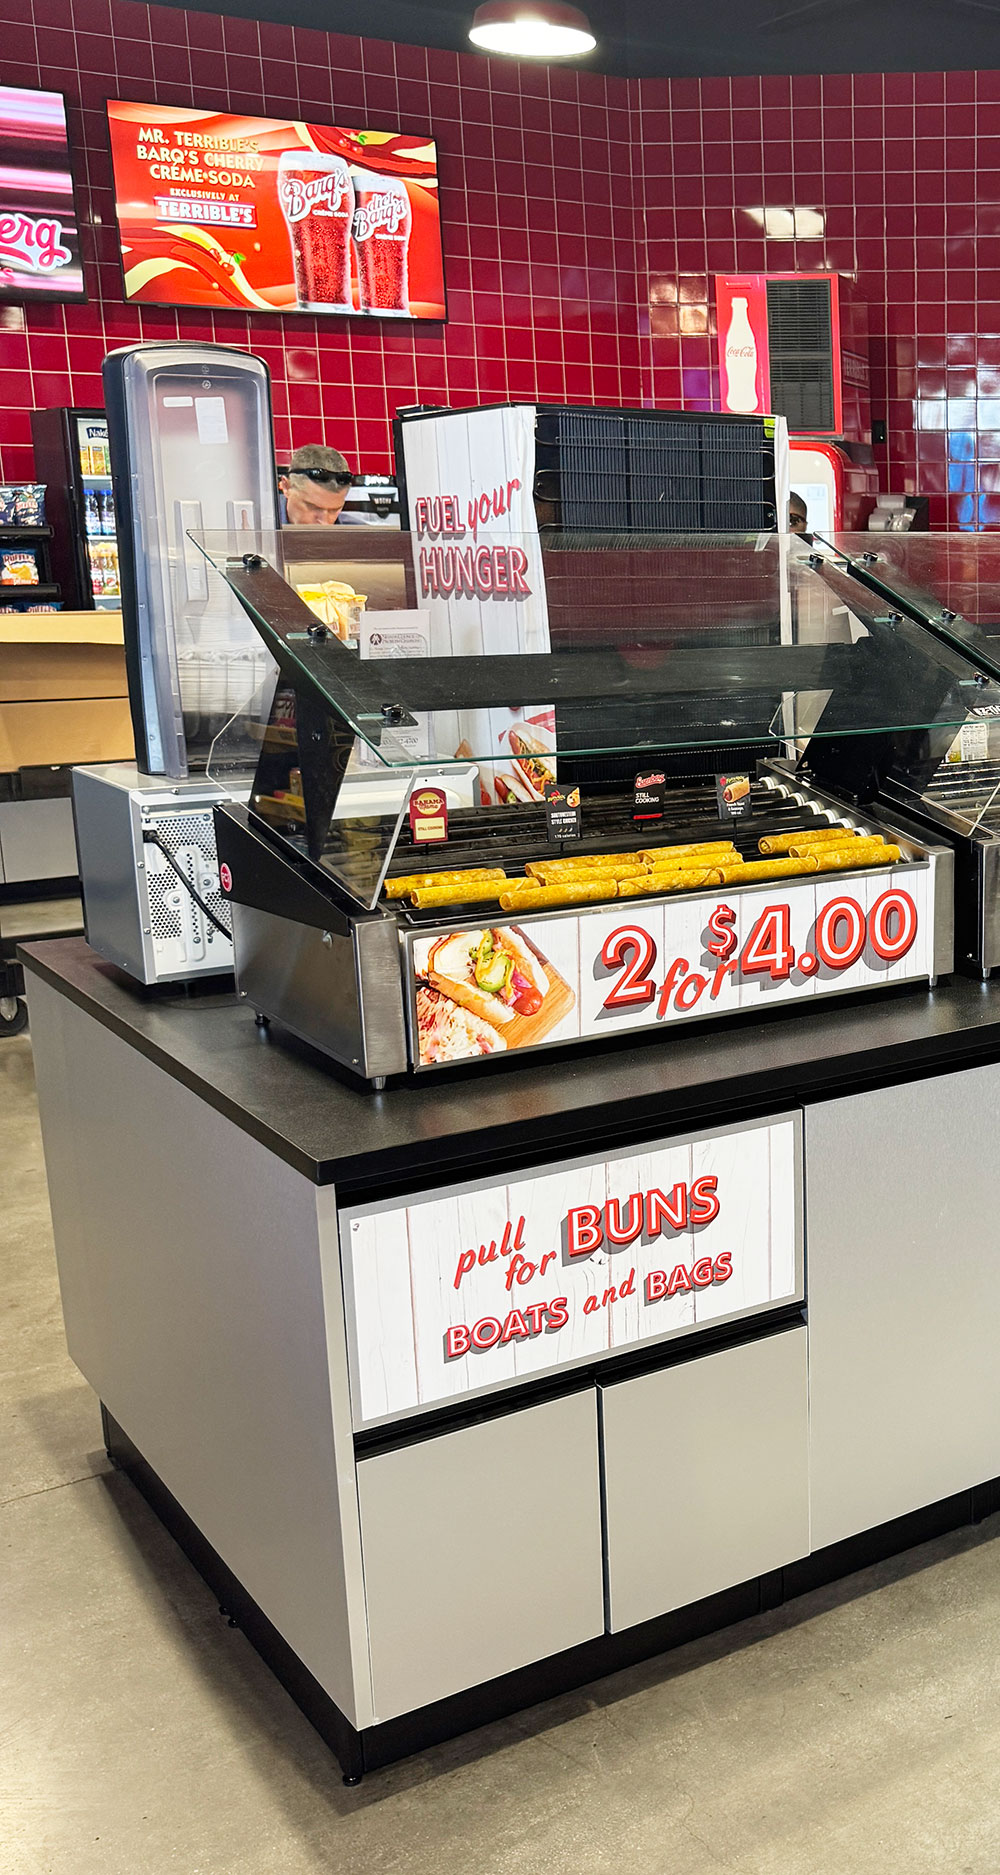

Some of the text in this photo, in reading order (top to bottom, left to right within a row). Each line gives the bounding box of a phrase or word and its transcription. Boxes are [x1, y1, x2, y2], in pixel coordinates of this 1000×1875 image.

[137, 145, 263, 171] BARQ'S CHERRY
[138, 127, 259, 153] MR. TERRIBLE'S
[157, 201, 253, 223] TERRIBLE'S
[169, 188, 239, 202] EXCLUSIVELY AT
[283, 169, 348, 222] Barq's
[353, 197, 407, 242] Barq's
[416, 478, 522, 543] FUEL your
[419, 545, 533, 597] HUNGER
[635, 796, 660, 804] COOKING
[601, 889, 918, 1019] 2 for $4.00
[453, 1175, 720, 1291] pull for BUNS
[446, 1252, 733, 1360] BOATS and BAGS
